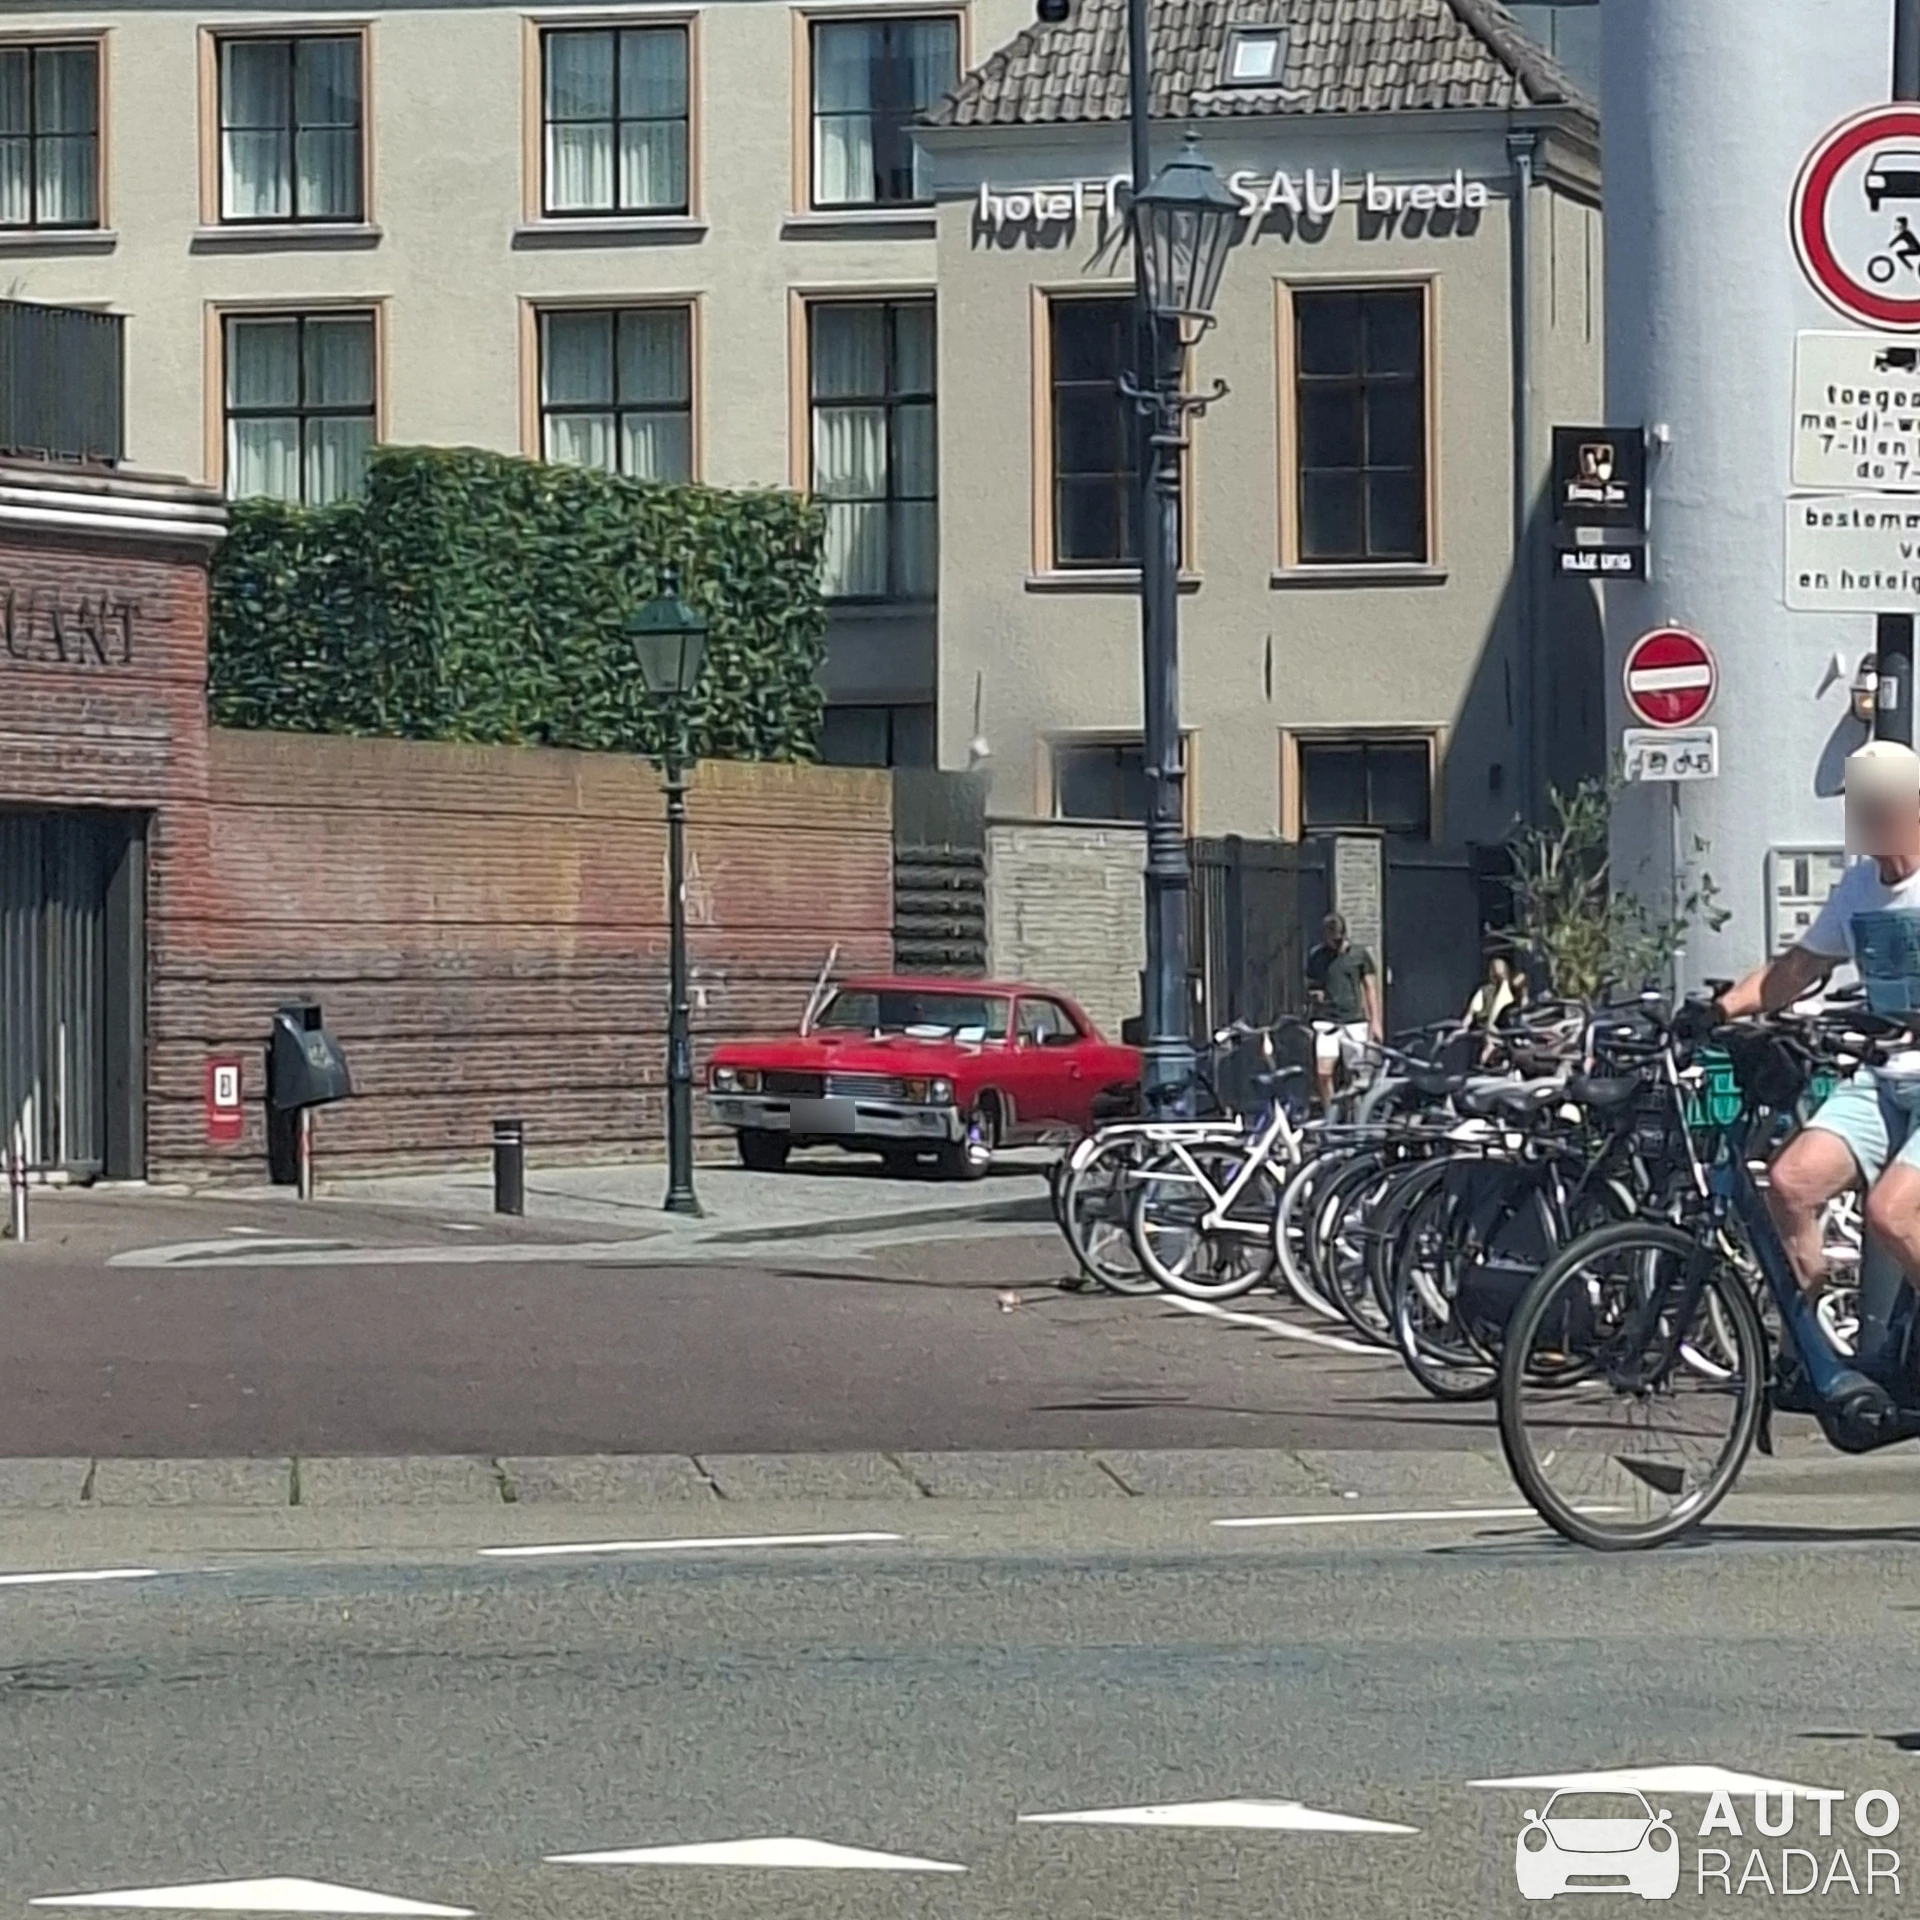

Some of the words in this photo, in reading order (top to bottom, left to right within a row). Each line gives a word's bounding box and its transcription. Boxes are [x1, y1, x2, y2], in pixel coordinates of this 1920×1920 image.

[980, 180, 1083, 222] hotel
[1366, 167, 1488, 212] breda
[1801, 410, 1920, 433] ma-di-w
[1799, 573, 1829, 590] en
